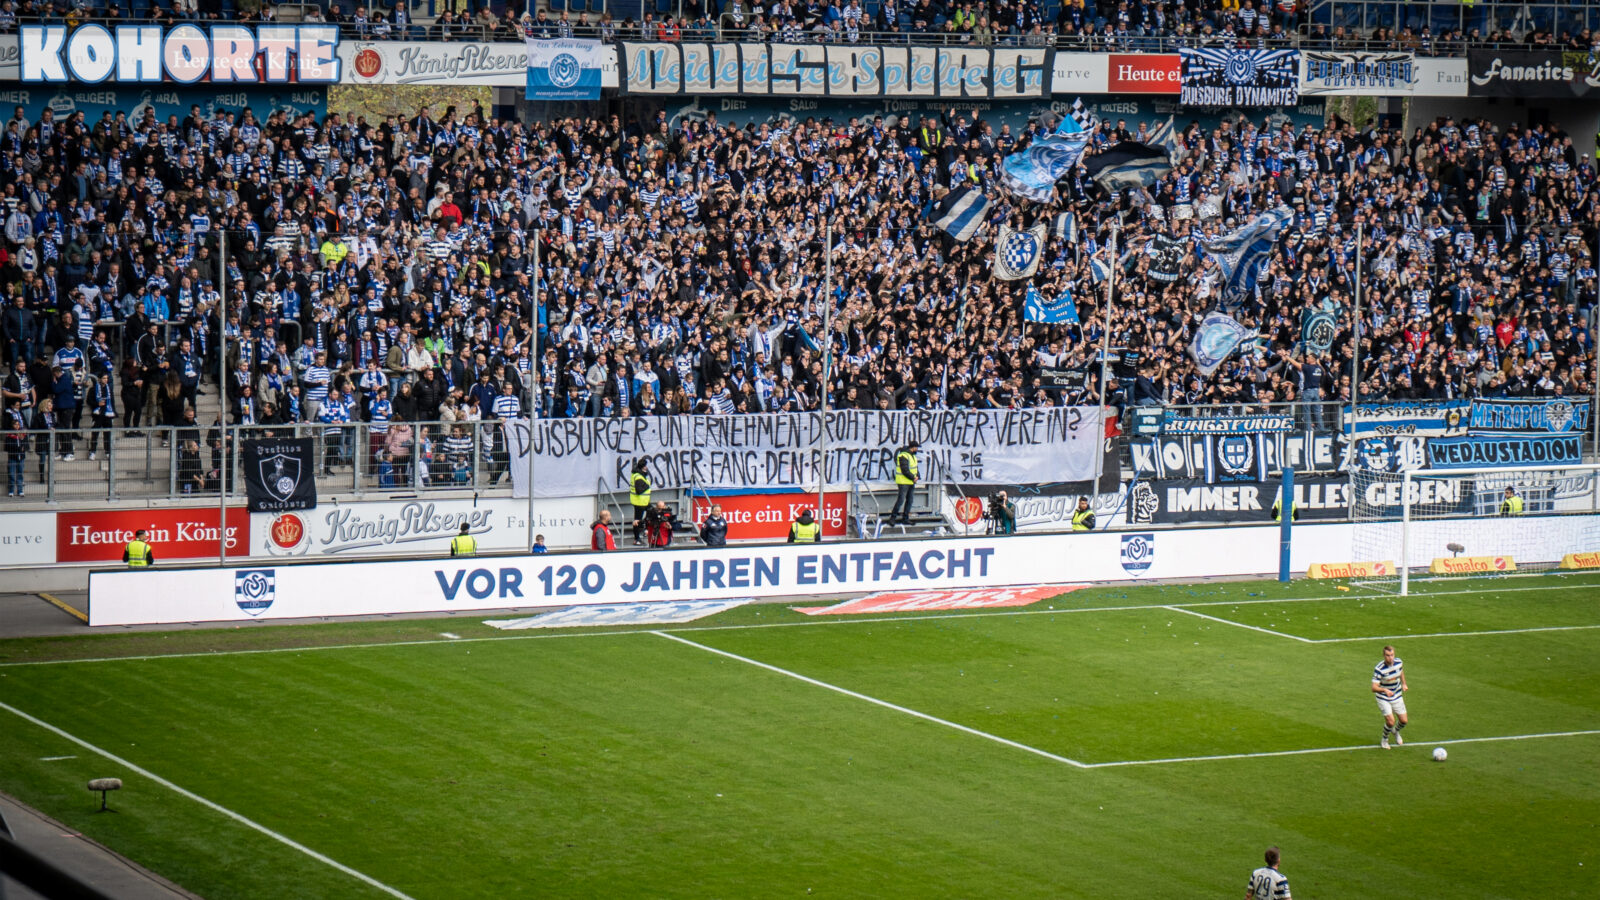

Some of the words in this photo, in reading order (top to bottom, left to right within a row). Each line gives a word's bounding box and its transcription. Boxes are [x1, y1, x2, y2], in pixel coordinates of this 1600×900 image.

[396, 46, 459, 76] König
[456, 44, 528, 72] Pilsene
[629, 46, 847, 90] Meidericher
[855, 50, 1044, 91] Spielverein
[1117, 64, 1164, 82] Heute
[1167, 66, 1181, 82] ei
[1471, 57, 1574, 86] Fanatics
[75, 91, 117, 105] SELIGER
[155, 91, 180, 105] JARA
[1101, 101, 1139, 114] WOLTERS
[1180, 86, 1232, 106] DUISBURG
[1235, 86, 1299, 107] DYNAMITES
[1470, 401, 1548, 428] METROPOL
[1572, 402, 1590, 430] 47
[658, 413, 801, 449] UNTERNEHMEN
[1431, 436, 1581, 465] WEDAUSTADION
[711, 451, 758, 485] FANG
[766, 450, 801, 486] DEN
[1166, 485, 1263, 513] IMMER
[1366, 480, 1461, 507] GEBEN!
[320, 507, 398, 545] König
[397, 502, 493, 536] Pilsener
[755, 505, 783, 523] ein
[69, 525, 135, 545] Heute
[434, 567, 524, 601] VOR
[537, 563, 606, 597] 120
[620, 556, 780, 593] JAHREN
[796, 547, 995, 585] ENTFACHT
[1320, 563, 1367, 579] Sinalco
[1443, 558, 1488, 573] Sinalco
[1255, 874, 1272, 898] 29
